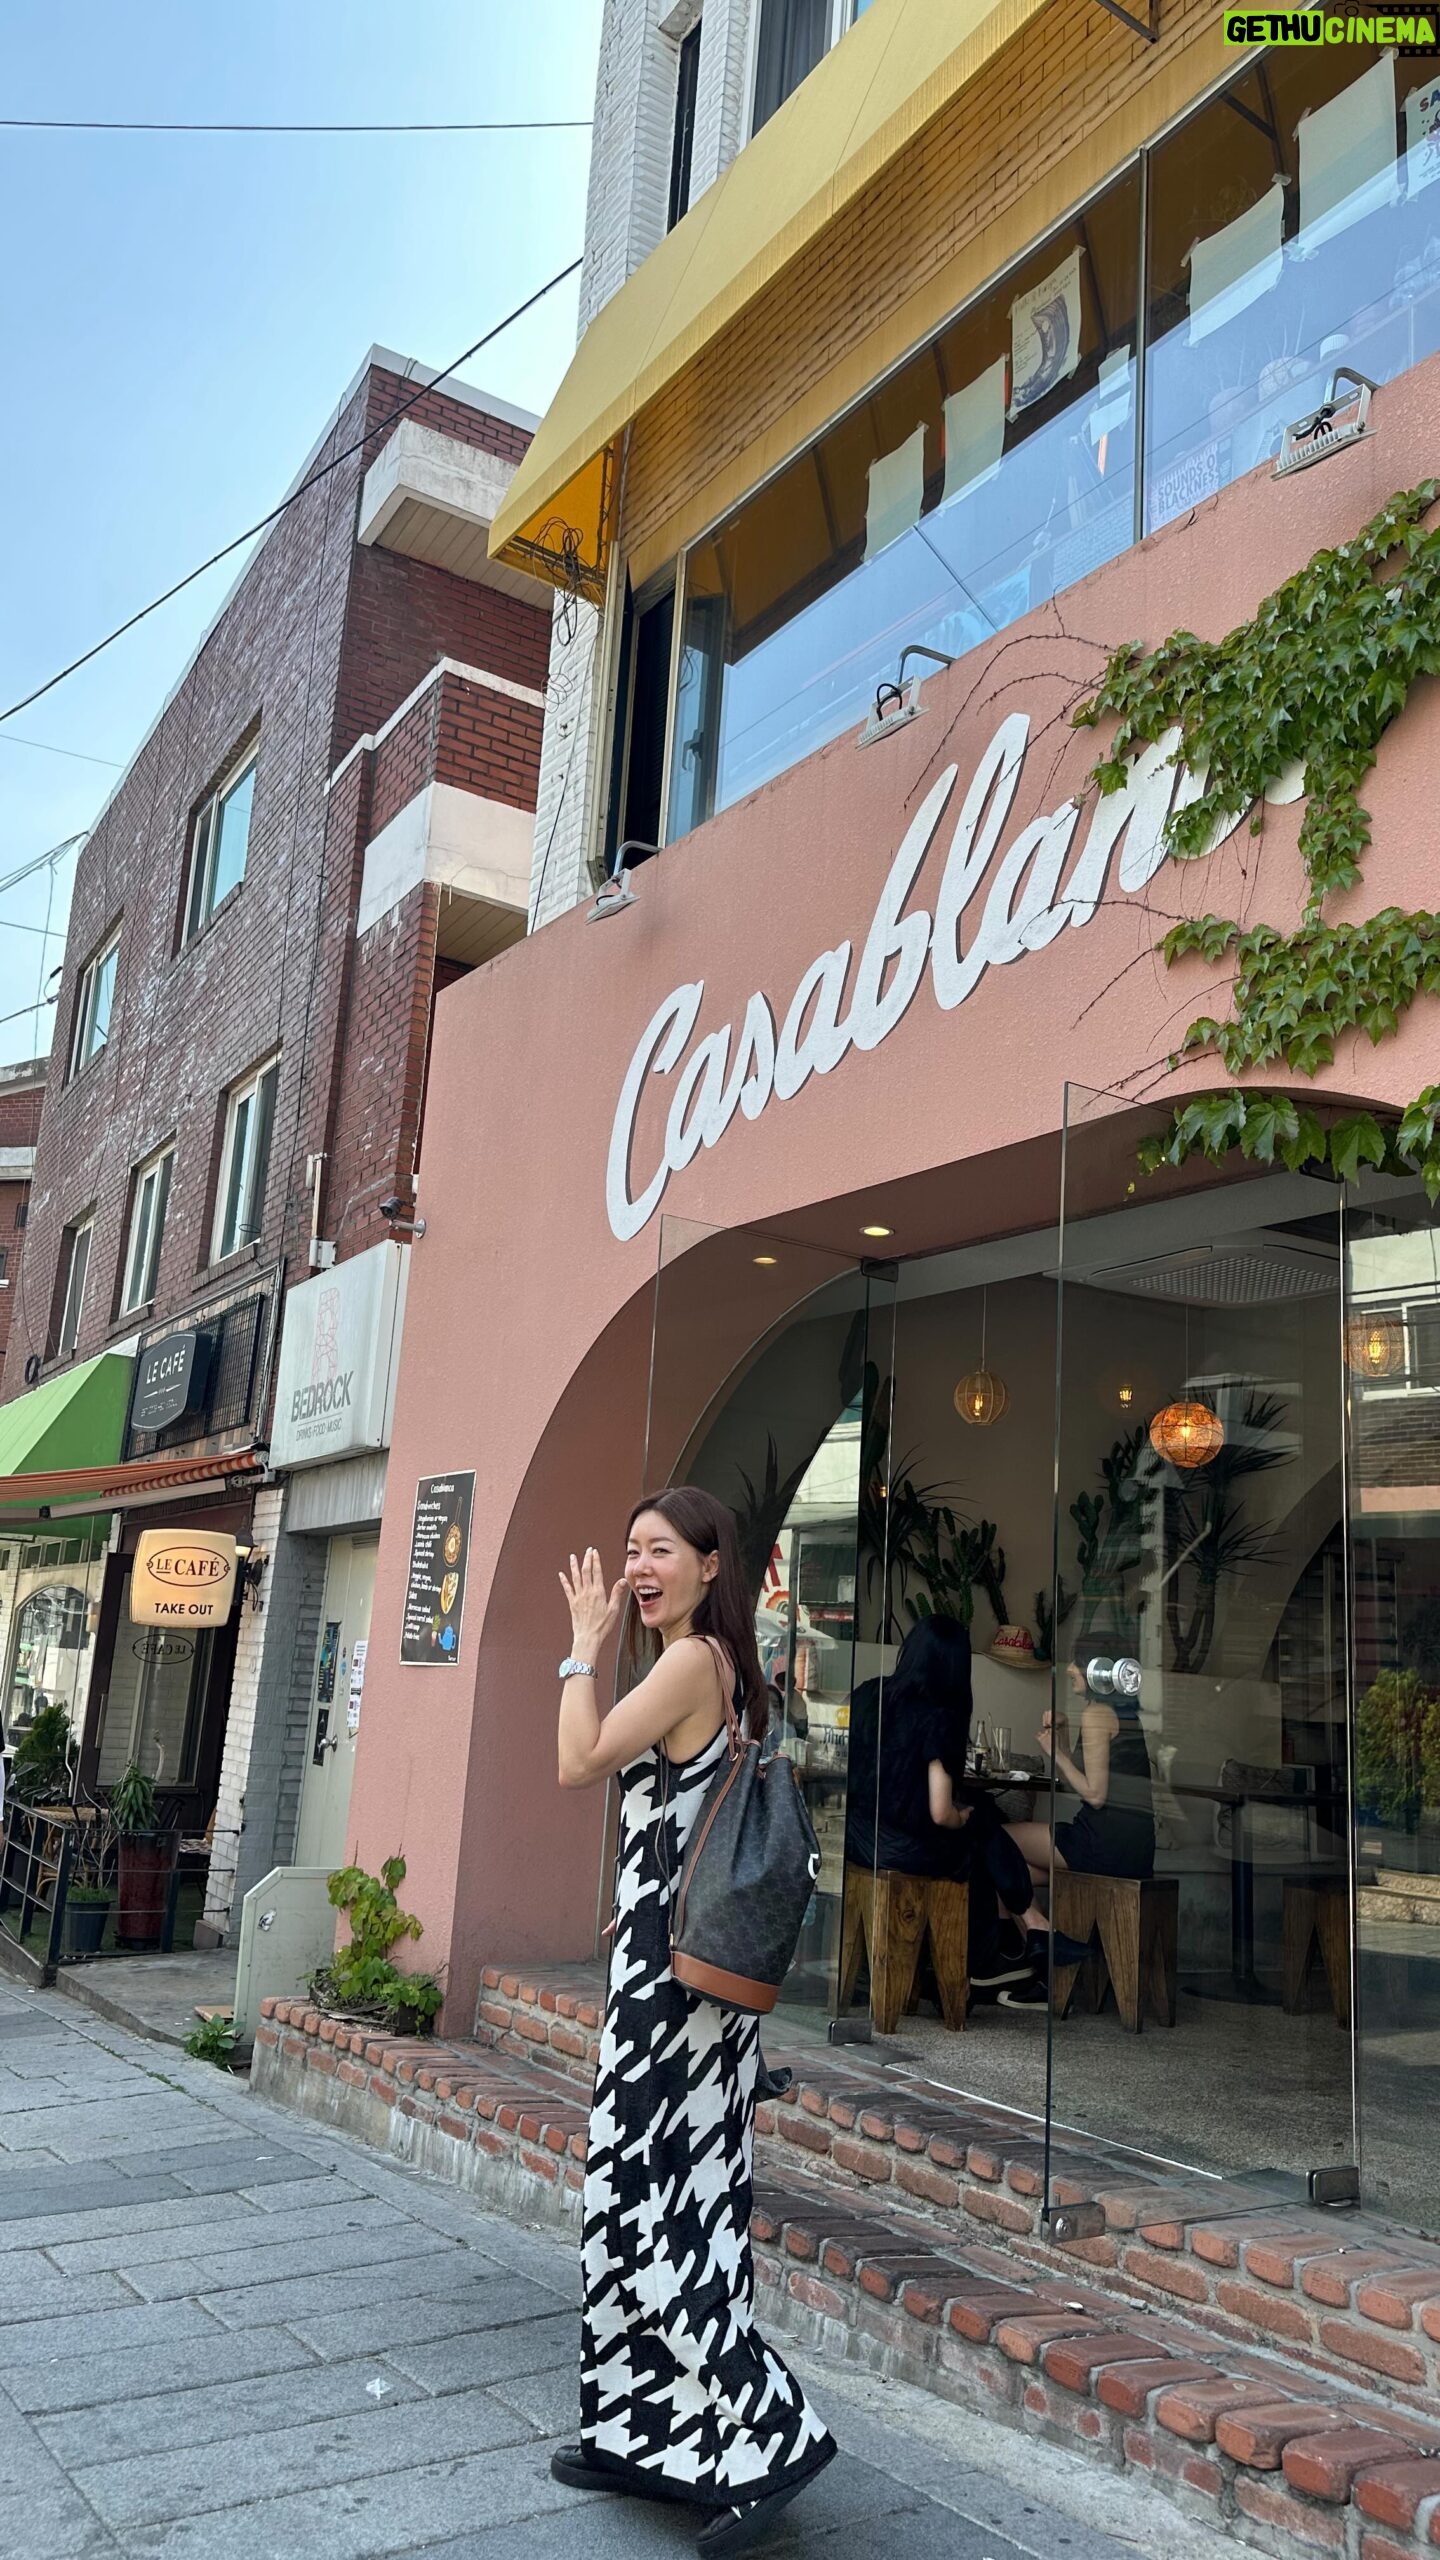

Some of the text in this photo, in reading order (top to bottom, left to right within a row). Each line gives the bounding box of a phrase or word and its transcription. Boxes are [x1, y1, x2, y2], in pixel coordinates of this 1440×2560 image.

[1158, 461, 1203, 501] SOUNDS
[606, 713, 1309, 1241] Casablan
[146, 1344, 186, 1385] LE CAFÉ
[290, 1371, 354, 1422] BEDROCK
[156, 1557, 220, 1576] LE CAFÉ
[154, 1602, 214, 1615] TAKE OUT
